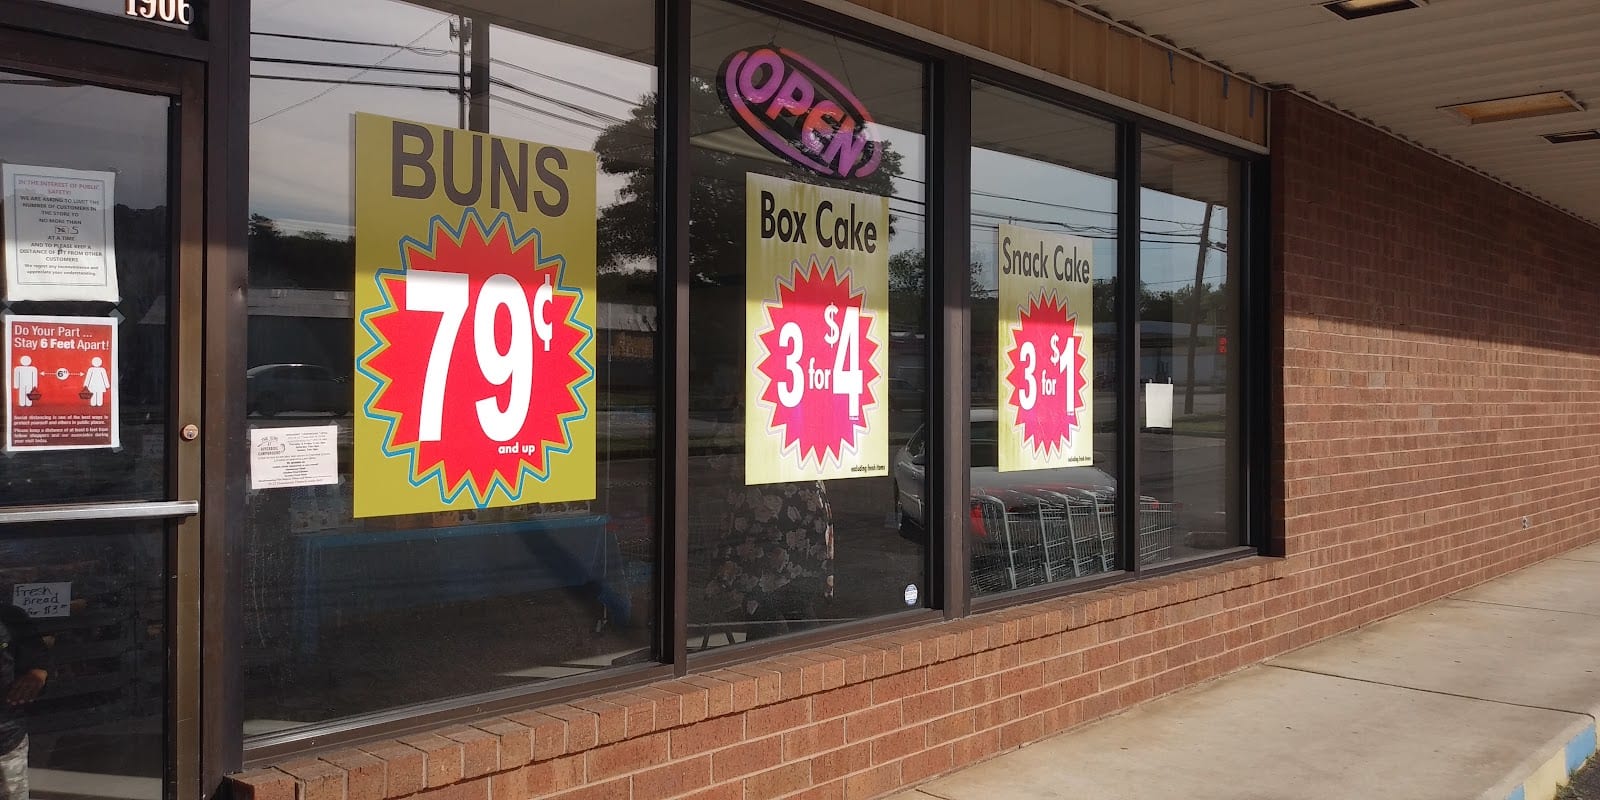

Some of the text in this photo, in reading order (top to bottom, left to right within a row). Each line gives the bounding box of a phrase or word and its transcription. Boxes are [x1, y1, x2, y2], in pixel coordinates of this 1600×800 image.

[739, 48, 867, 177] OPEN
[391, 120, 569, 218] BUNS
[761, 190, 877, 254] Box Cake
[1002, 236, 1090, 284] Snack Cake
[14, 325, 29, 335] Do
[32, 326, 55, 336] Your
[58, 327, 80, 337] Part
[14, 337, 109, 351] Stay 6 Feet Apart!
[405, 269, 553, 442] 79¢
[777, 301, 863, 420] 3 for $4
[1018, 332, 1075, 416] 3 for $1
[498, 441, 535, 456] and up
[16, 586, 52, 596] Fresh
[23, 592, 59, 605] Bread
